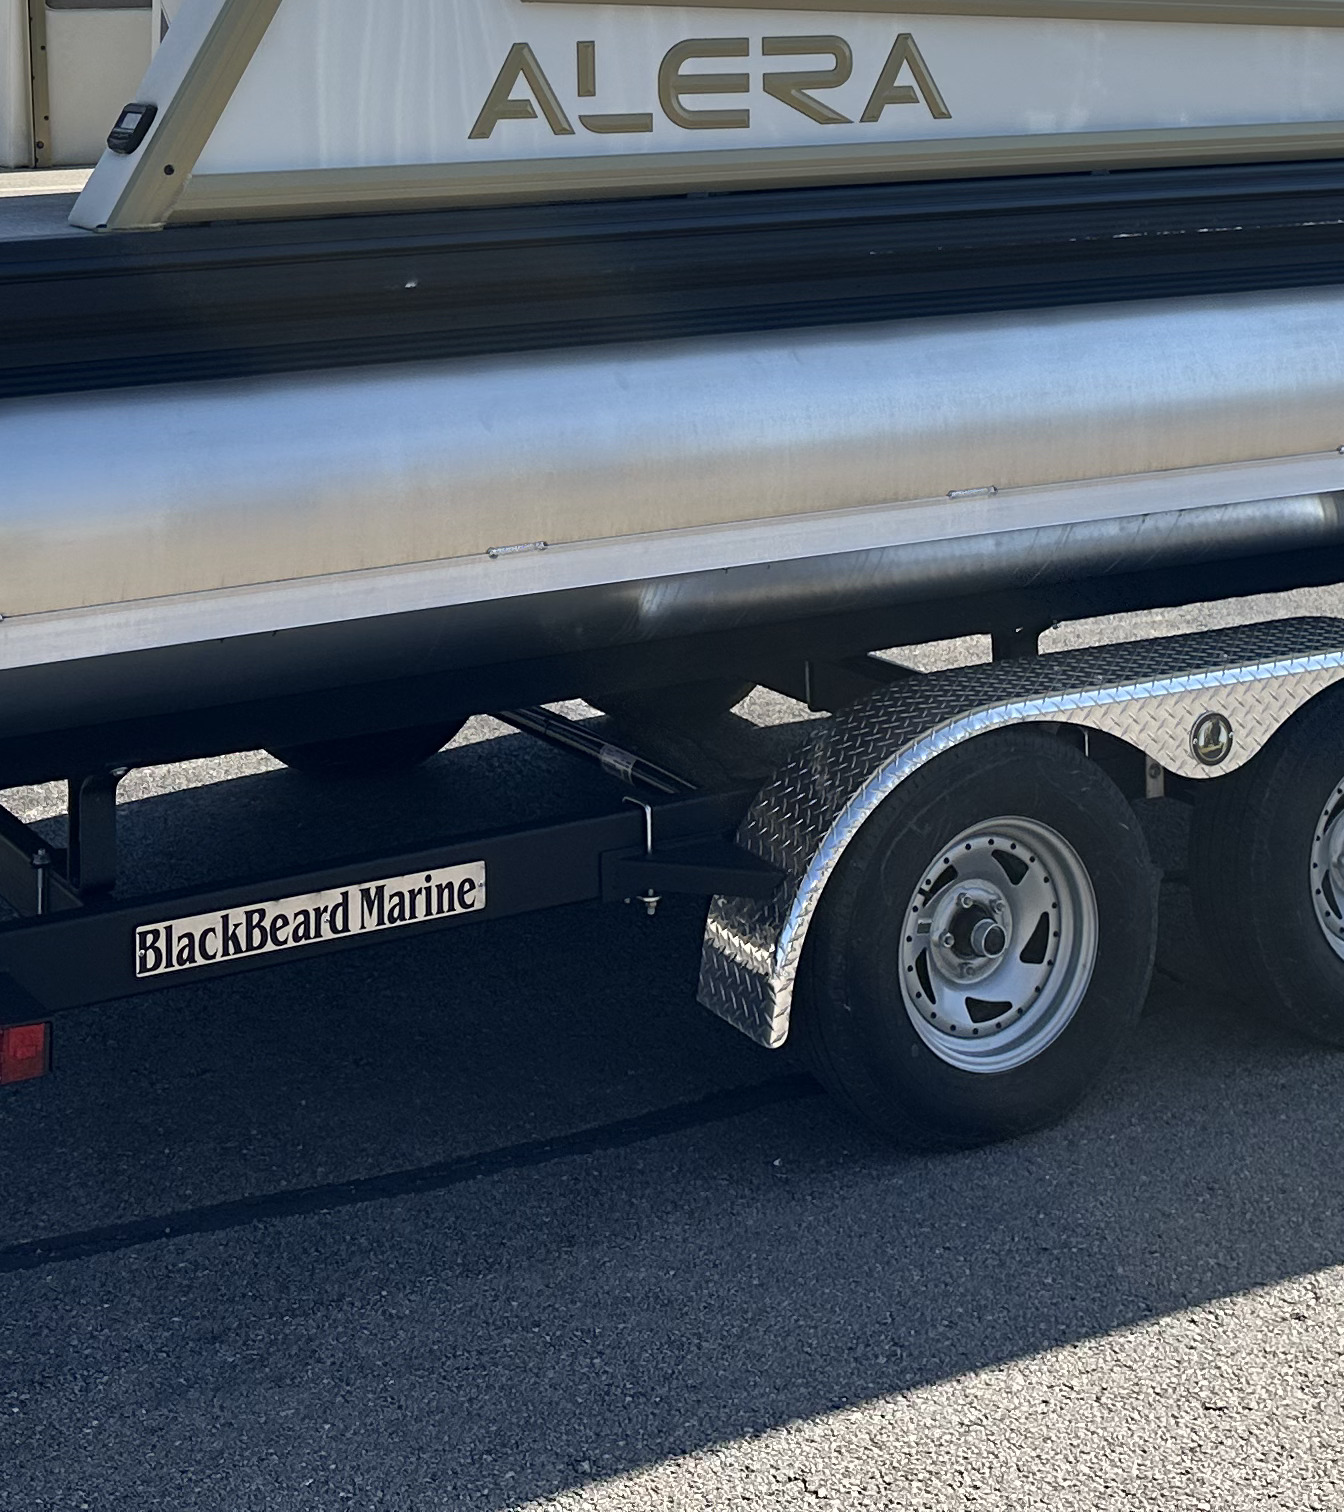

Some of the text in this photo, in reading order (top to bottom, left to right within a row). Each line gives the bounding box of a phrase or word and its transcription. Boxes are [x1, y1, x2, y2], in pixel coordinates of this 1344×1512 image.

[467, 32, 953, 139] ALERA
[136, 874, 477, 975] BlackBeard Marine
